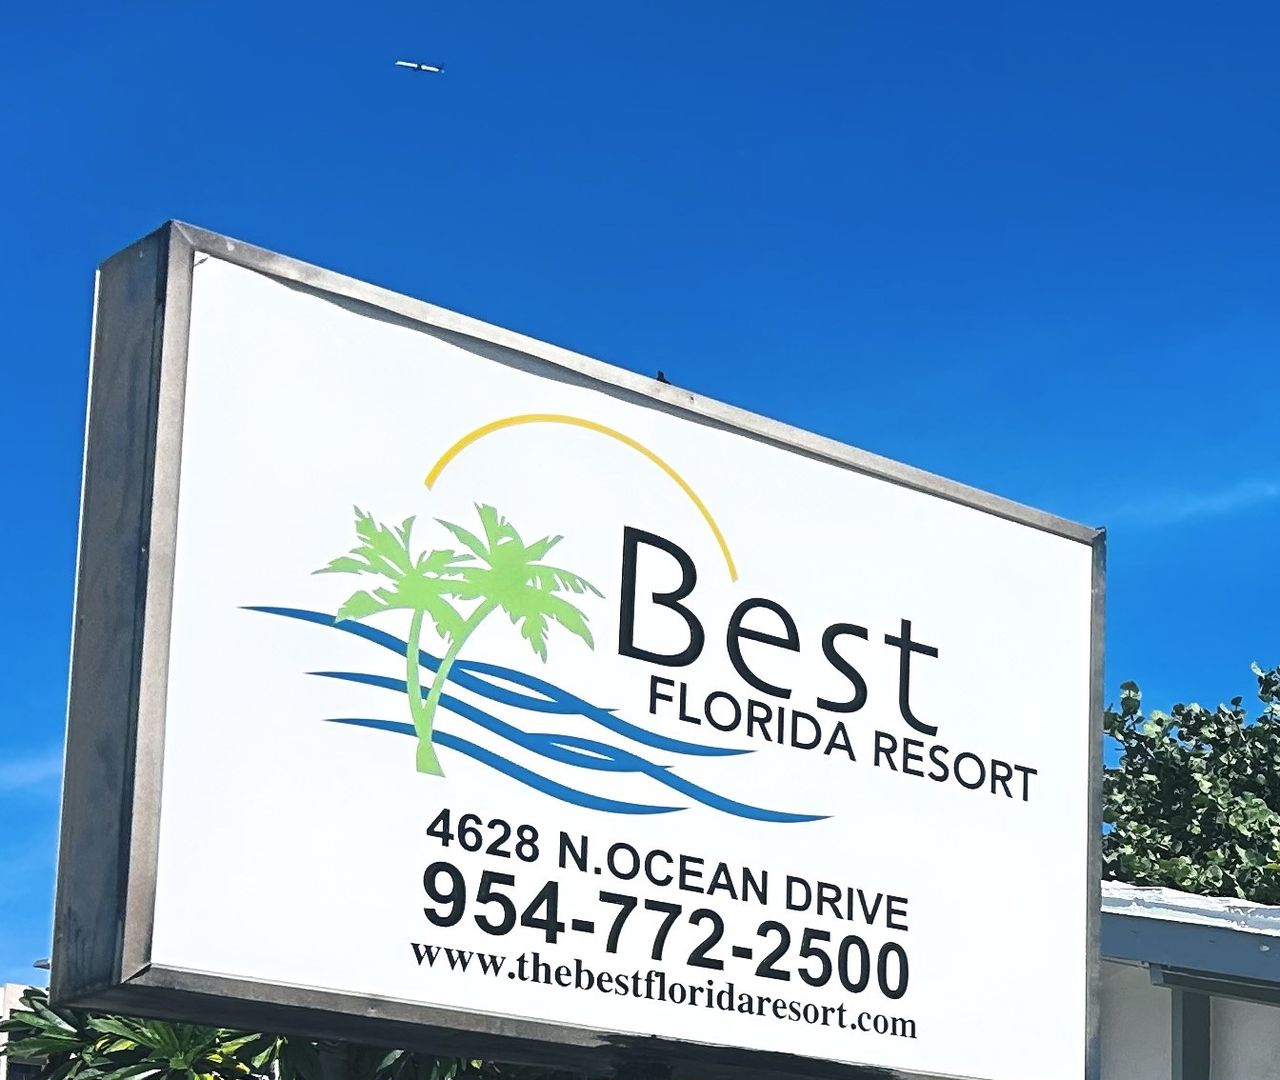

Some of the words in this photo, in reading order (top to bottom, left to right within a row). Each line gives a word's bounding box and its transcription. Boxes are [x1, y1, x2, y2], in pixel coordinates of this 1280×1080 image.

[618, 525, 938, 737] Best
[649, 674, 857, 762] FLORIDA
[873, 730, 1038, 802] RESORT
[423, 861, 909, 1000] 954-772-2500
[426, 808, 540, 863] 4628
[558, 831, 768, 906] N.OCEAN
[786, 875, 909, 932] DRIVE
[410, 942, 917, 1039] www.thebestfloridaresort.com
